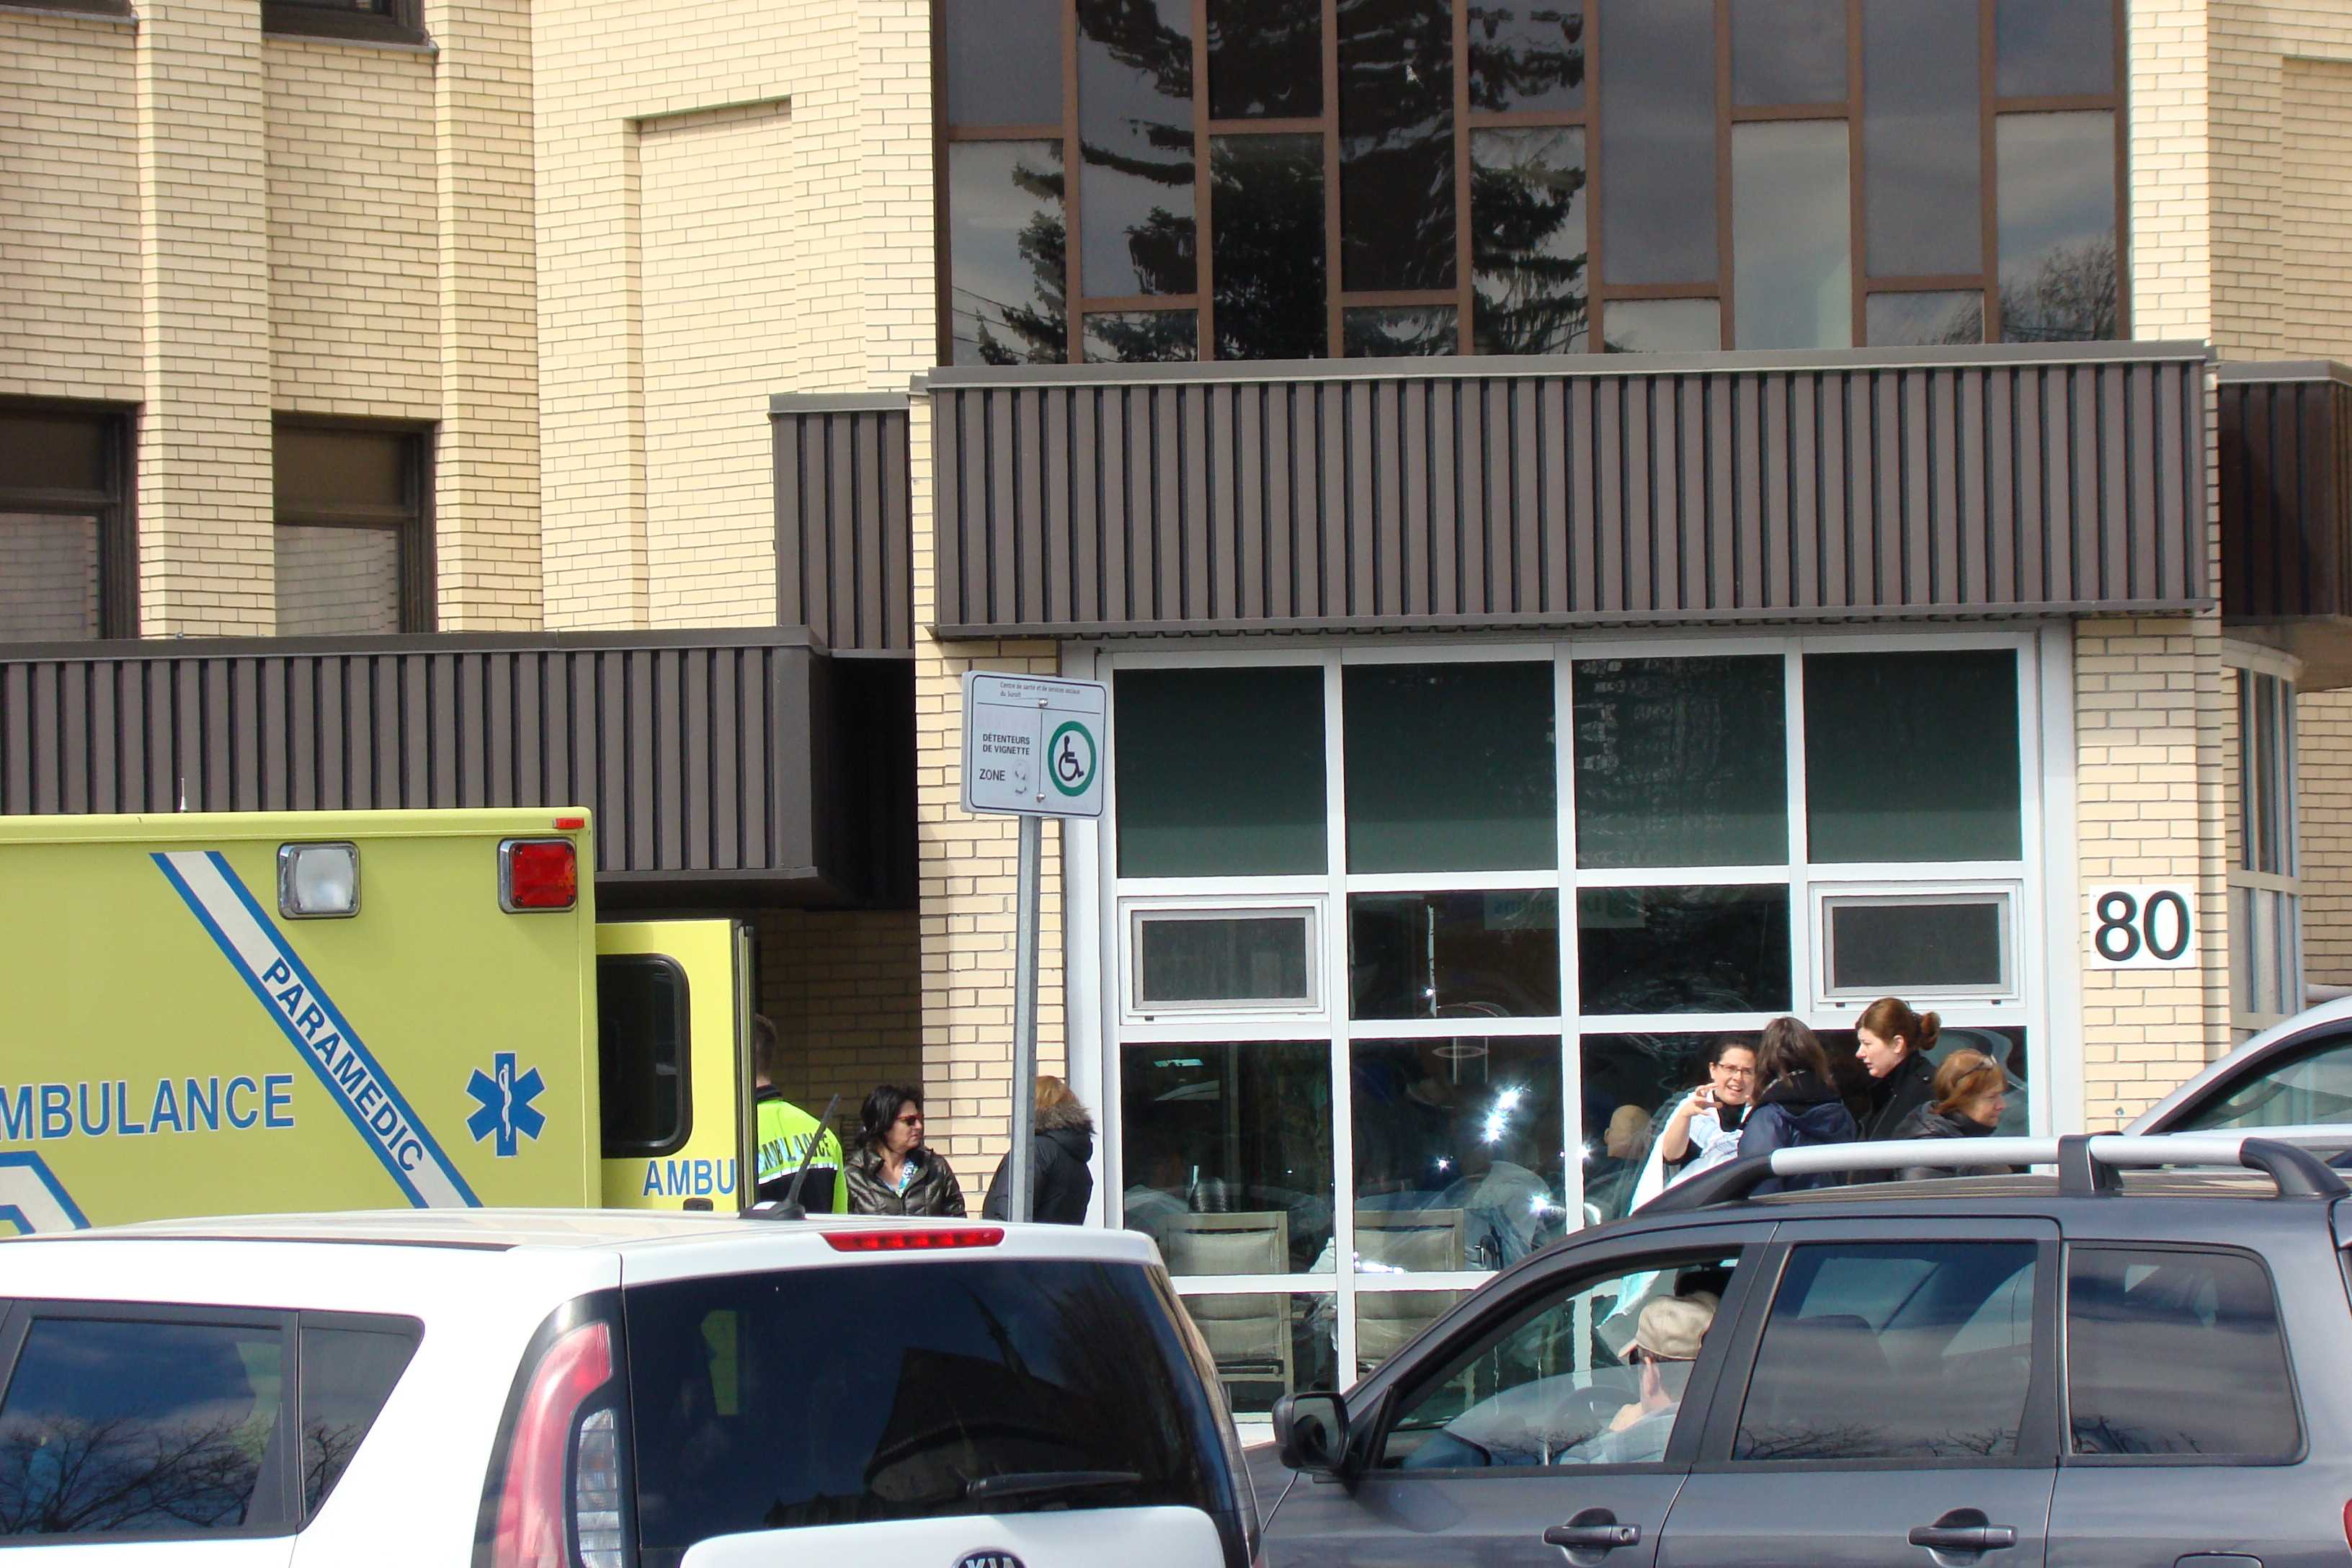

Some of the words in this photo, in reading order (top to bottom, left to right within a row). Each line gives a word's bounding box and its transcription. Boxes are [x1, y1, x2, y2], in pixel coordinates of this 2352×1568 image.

[983, 732, 1030, 745] DÉTENTEURS
[983, 744, 992, 753] DE
[994, 745, 1030, 755] VIGNETTE
[979, 769, 1006, 781] ZONE
[2095, 890, 2176, 962] 80
[262, 956, 424, 1172] PARAMEDIC
[643, 1159, 736, 1197] AMBU
